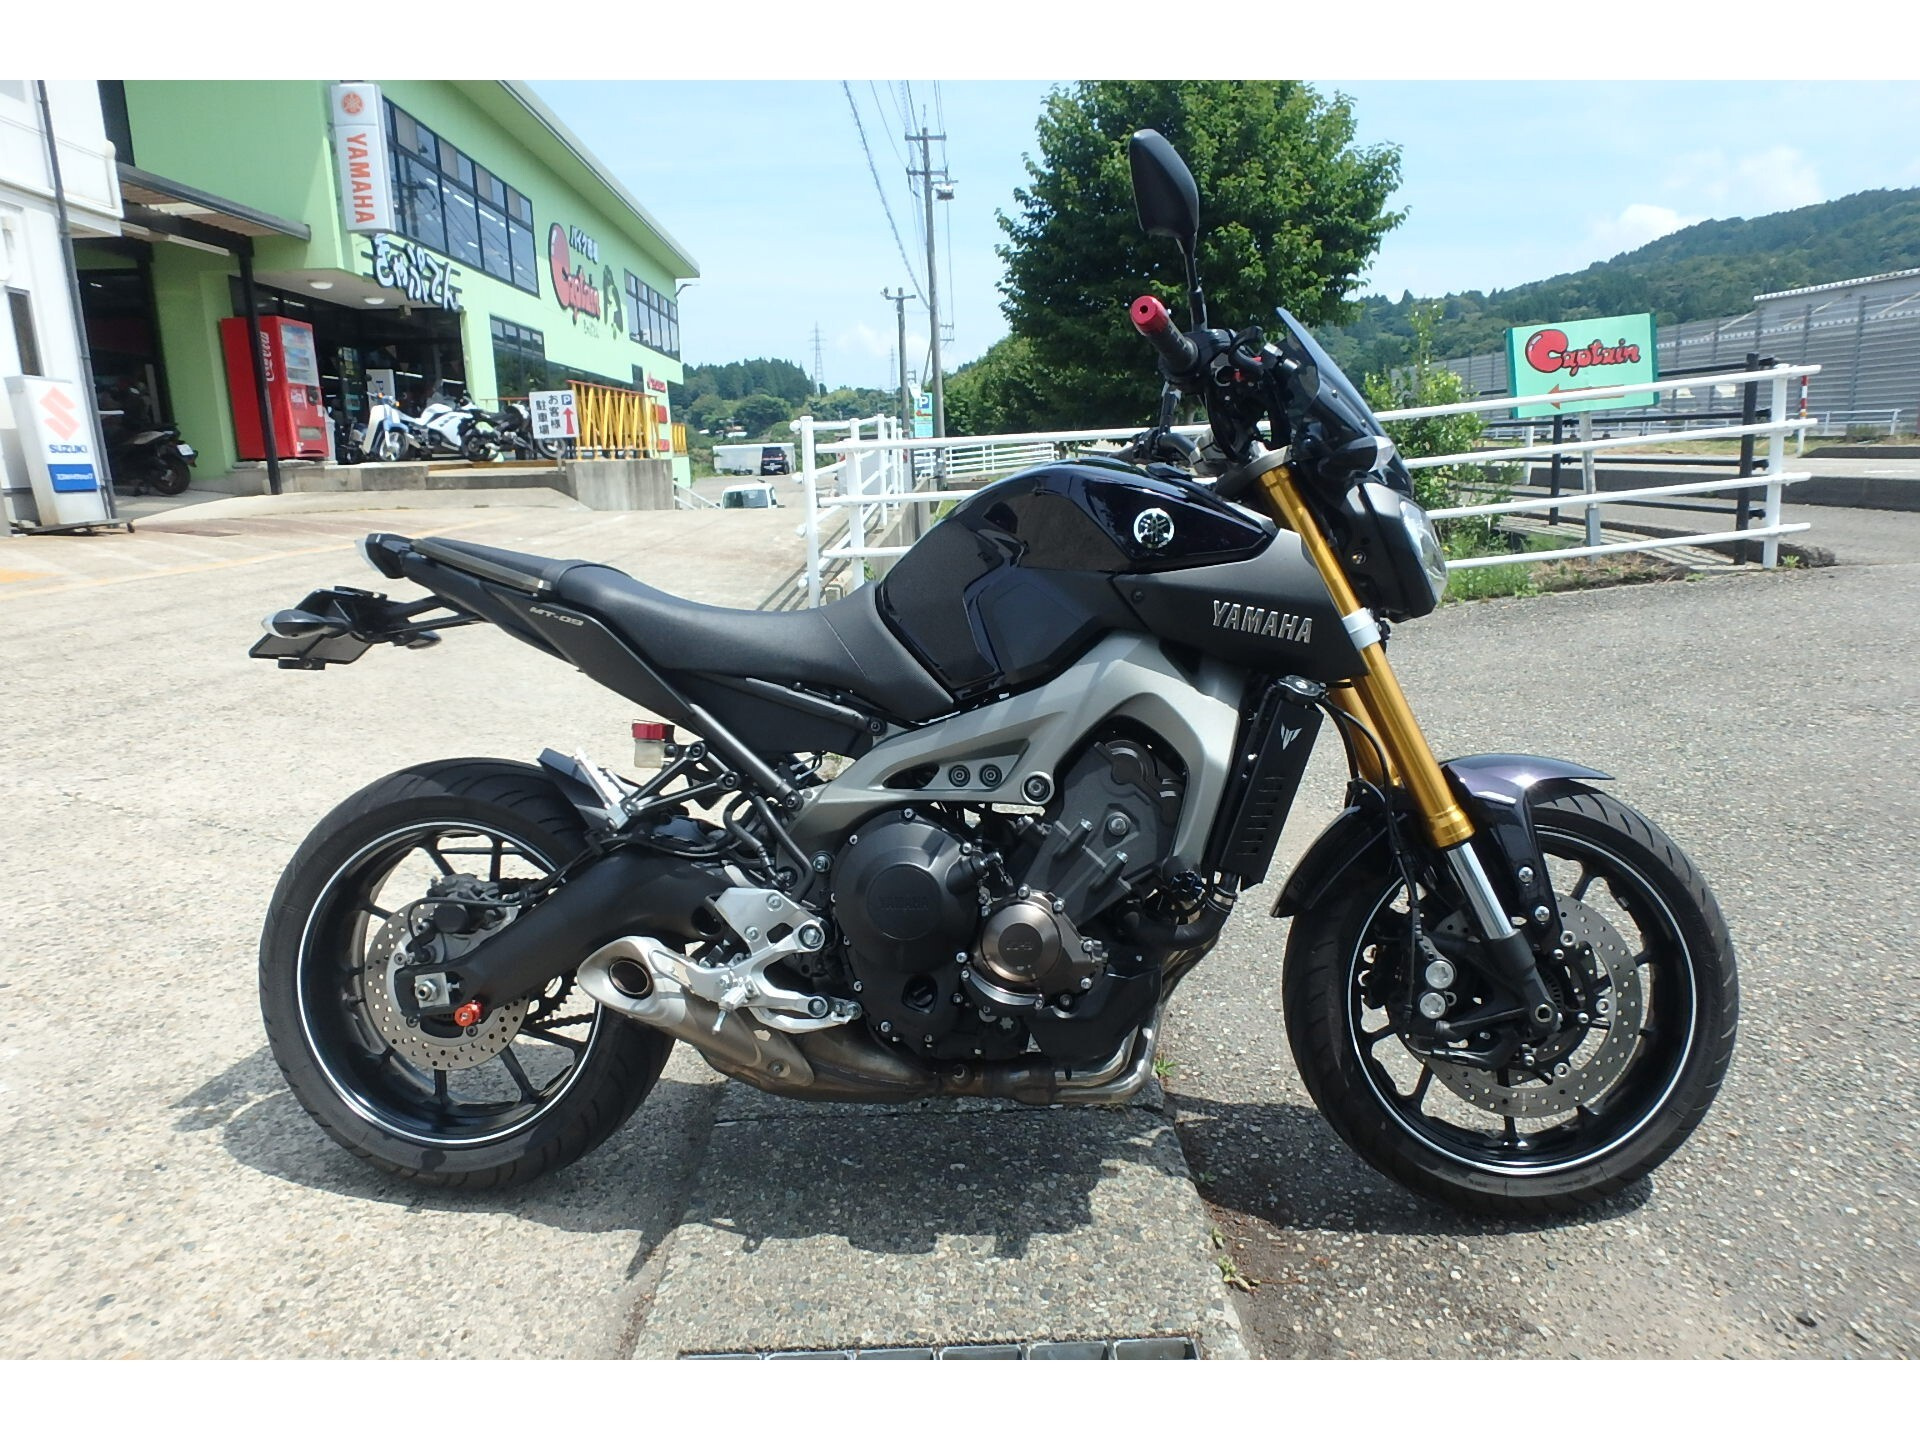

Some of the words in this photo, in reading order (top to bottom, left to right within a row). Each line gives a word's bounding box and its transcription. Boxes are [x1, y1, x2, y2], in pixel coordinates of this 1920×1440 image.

[346, 133, 375, 223] YAMAHA
[373, 232, 462, 313] きゃぷてん
[548, 222, 601, 326] Captain
[1525, 328, 1641, 377] Captain
[536, 400, 549, 434] 駐車場
[548, 395, 560, 428] お客様
[49, 444, 88, 453] SUZUKI
[530, 606, 584, 626] MT-09
[1212, 600, 1312, 643] YAMAHA
